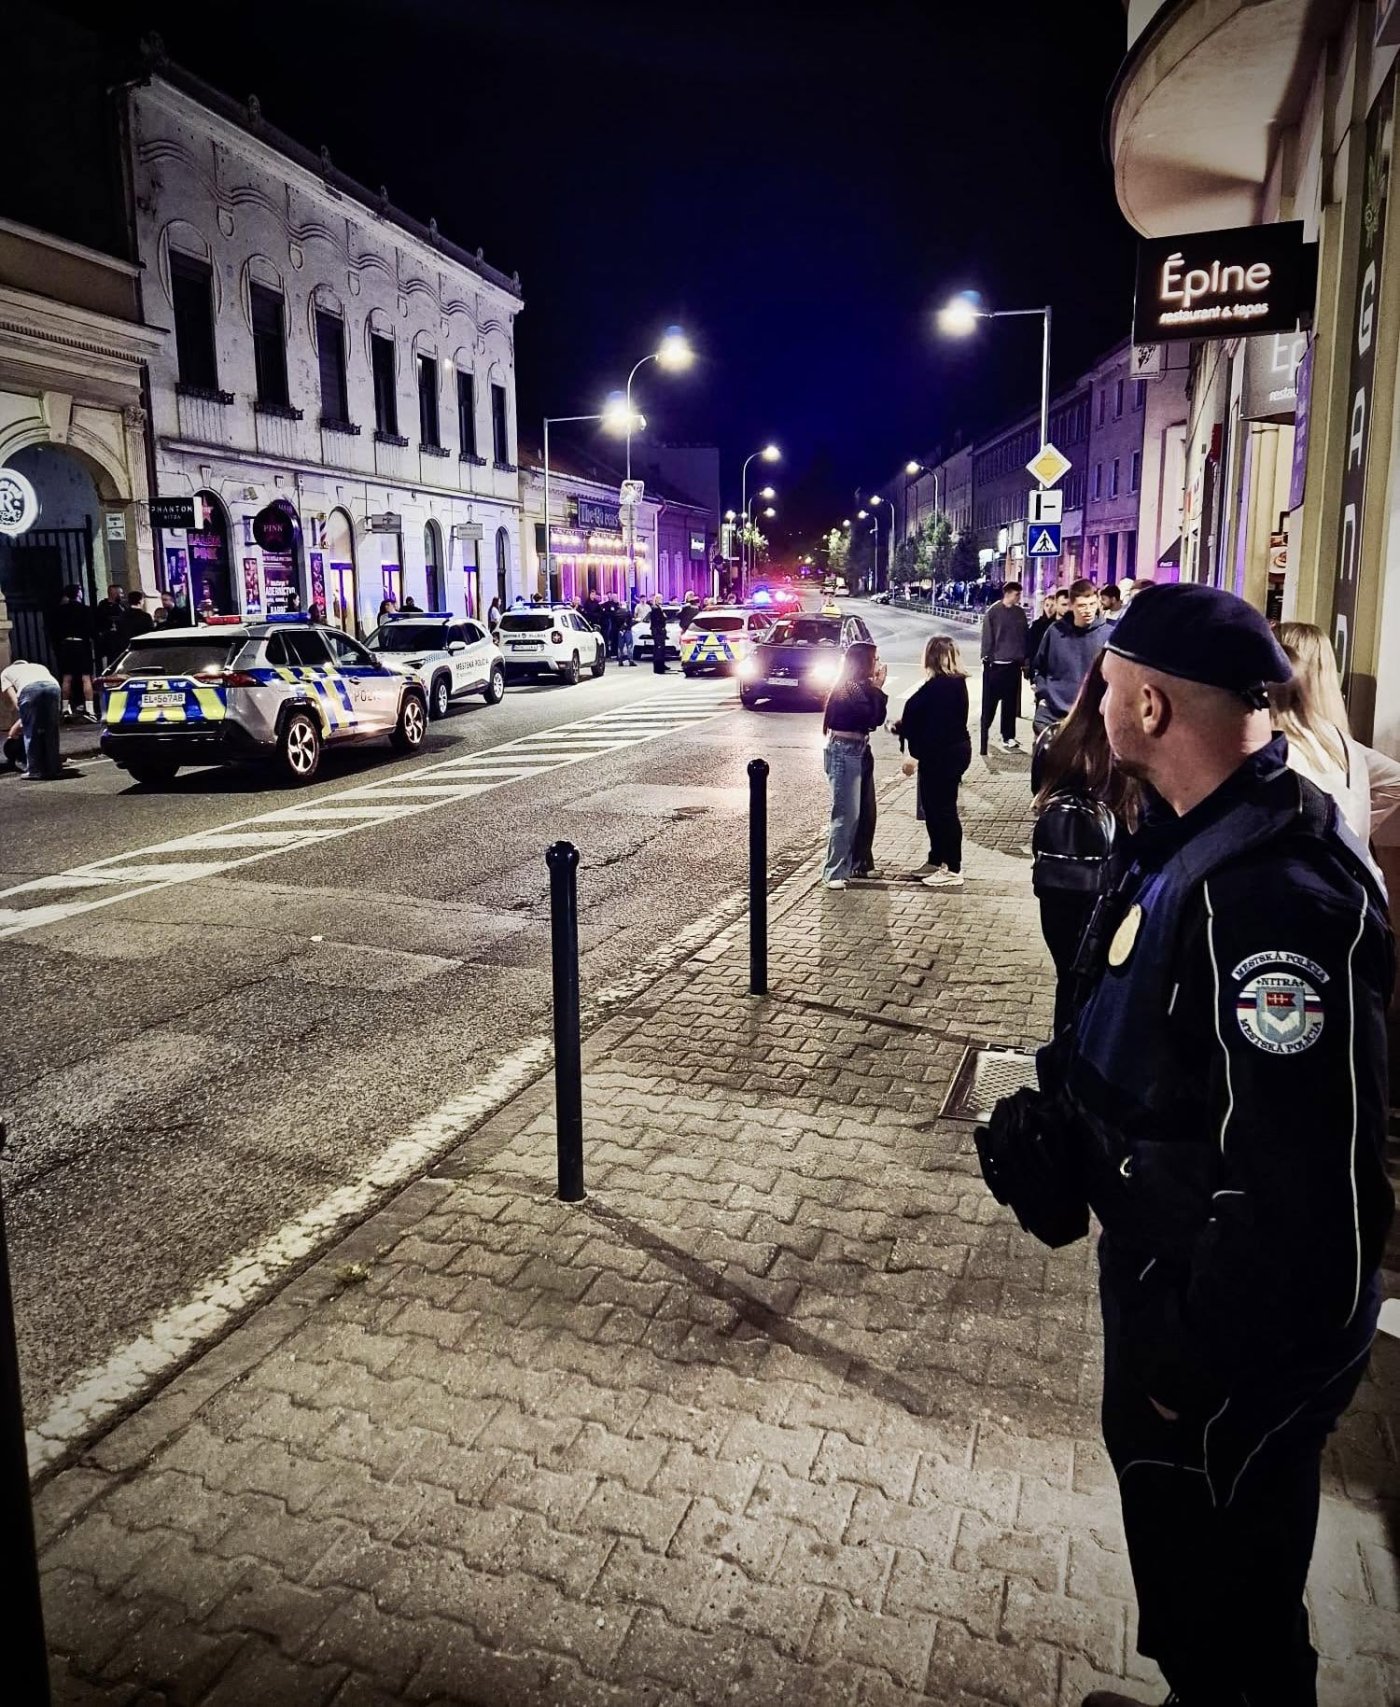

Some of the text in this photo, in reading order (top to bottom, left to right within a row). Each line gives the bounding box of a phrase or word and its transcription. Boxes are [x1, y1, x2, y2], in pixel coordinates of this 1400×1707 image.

[1159, 252, 1271, 308] Épine
[1159, 306, 1221, 324] restaurant
[1221, 306, 1233, 318] &
[151, 505, 193, 513] PHANTOM
[263, 524, 283, 533] PINK
[1261, 978, 1300, 987] NITRA
